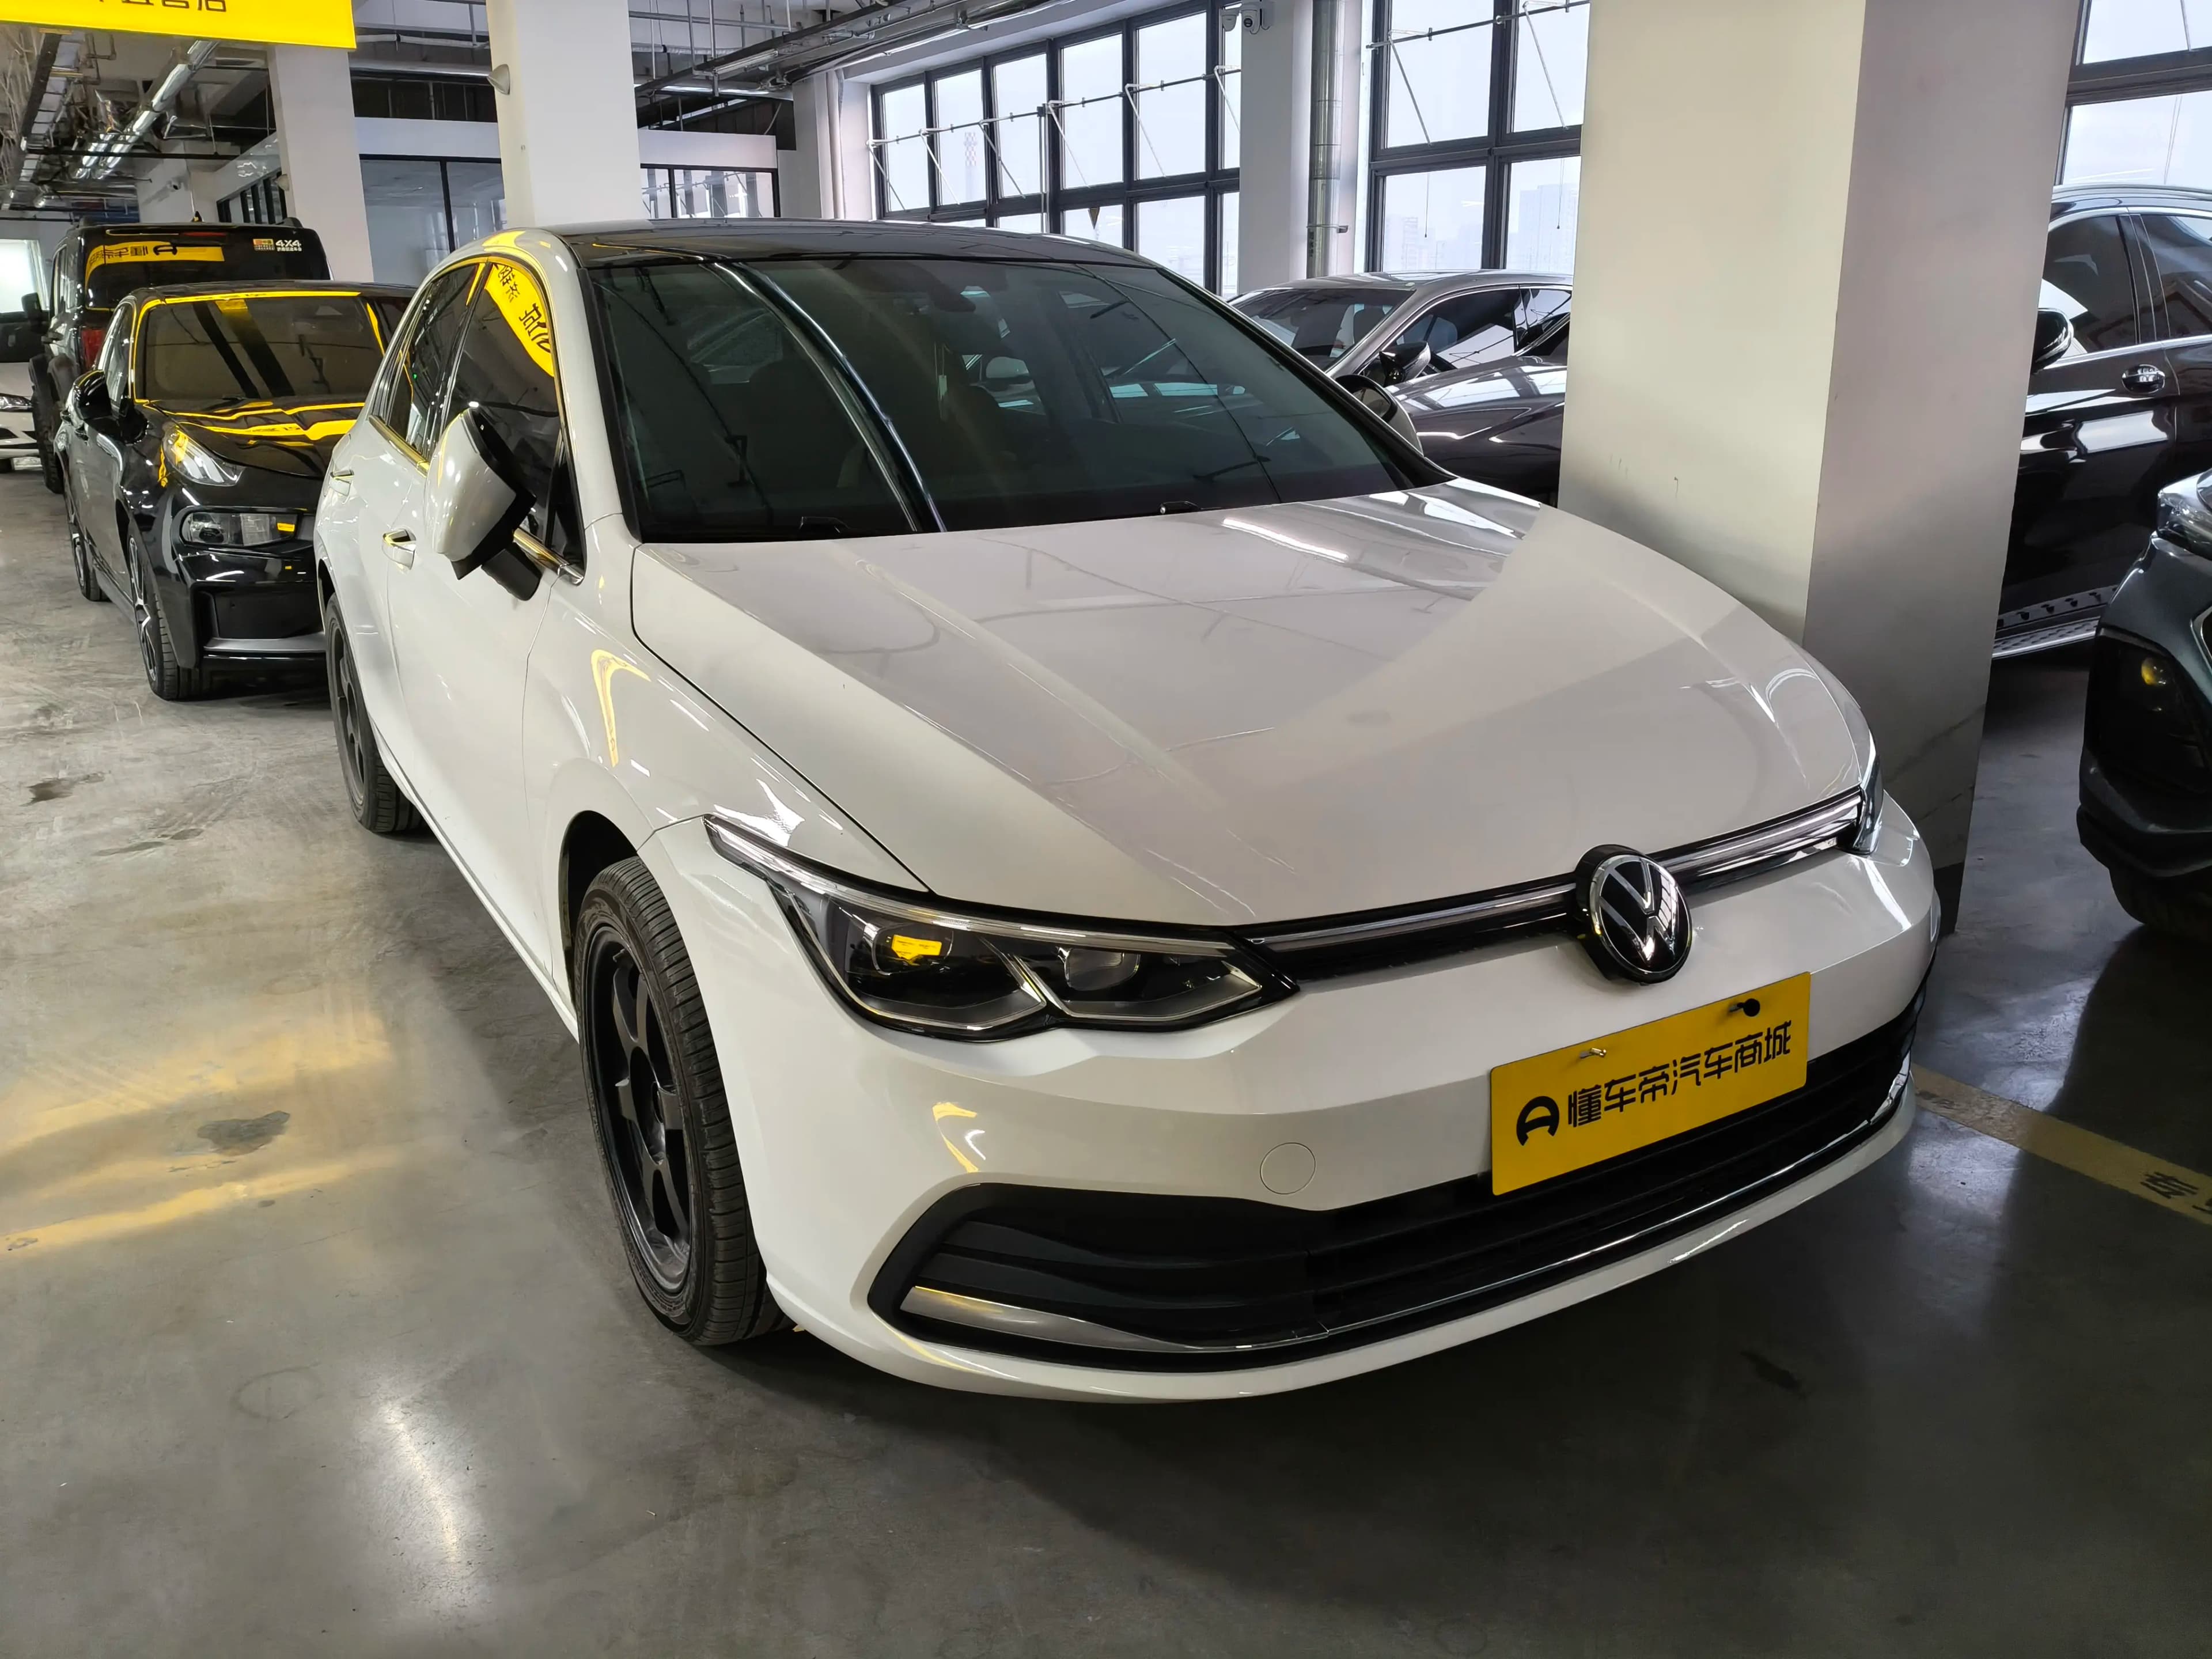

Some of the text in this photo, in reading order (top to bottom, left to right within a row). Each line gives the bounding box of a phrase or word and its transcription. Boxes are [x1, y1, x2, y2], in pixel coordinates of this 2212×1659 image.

[1568, 1020, 1791, 1127] 懂车帝汽车商城
